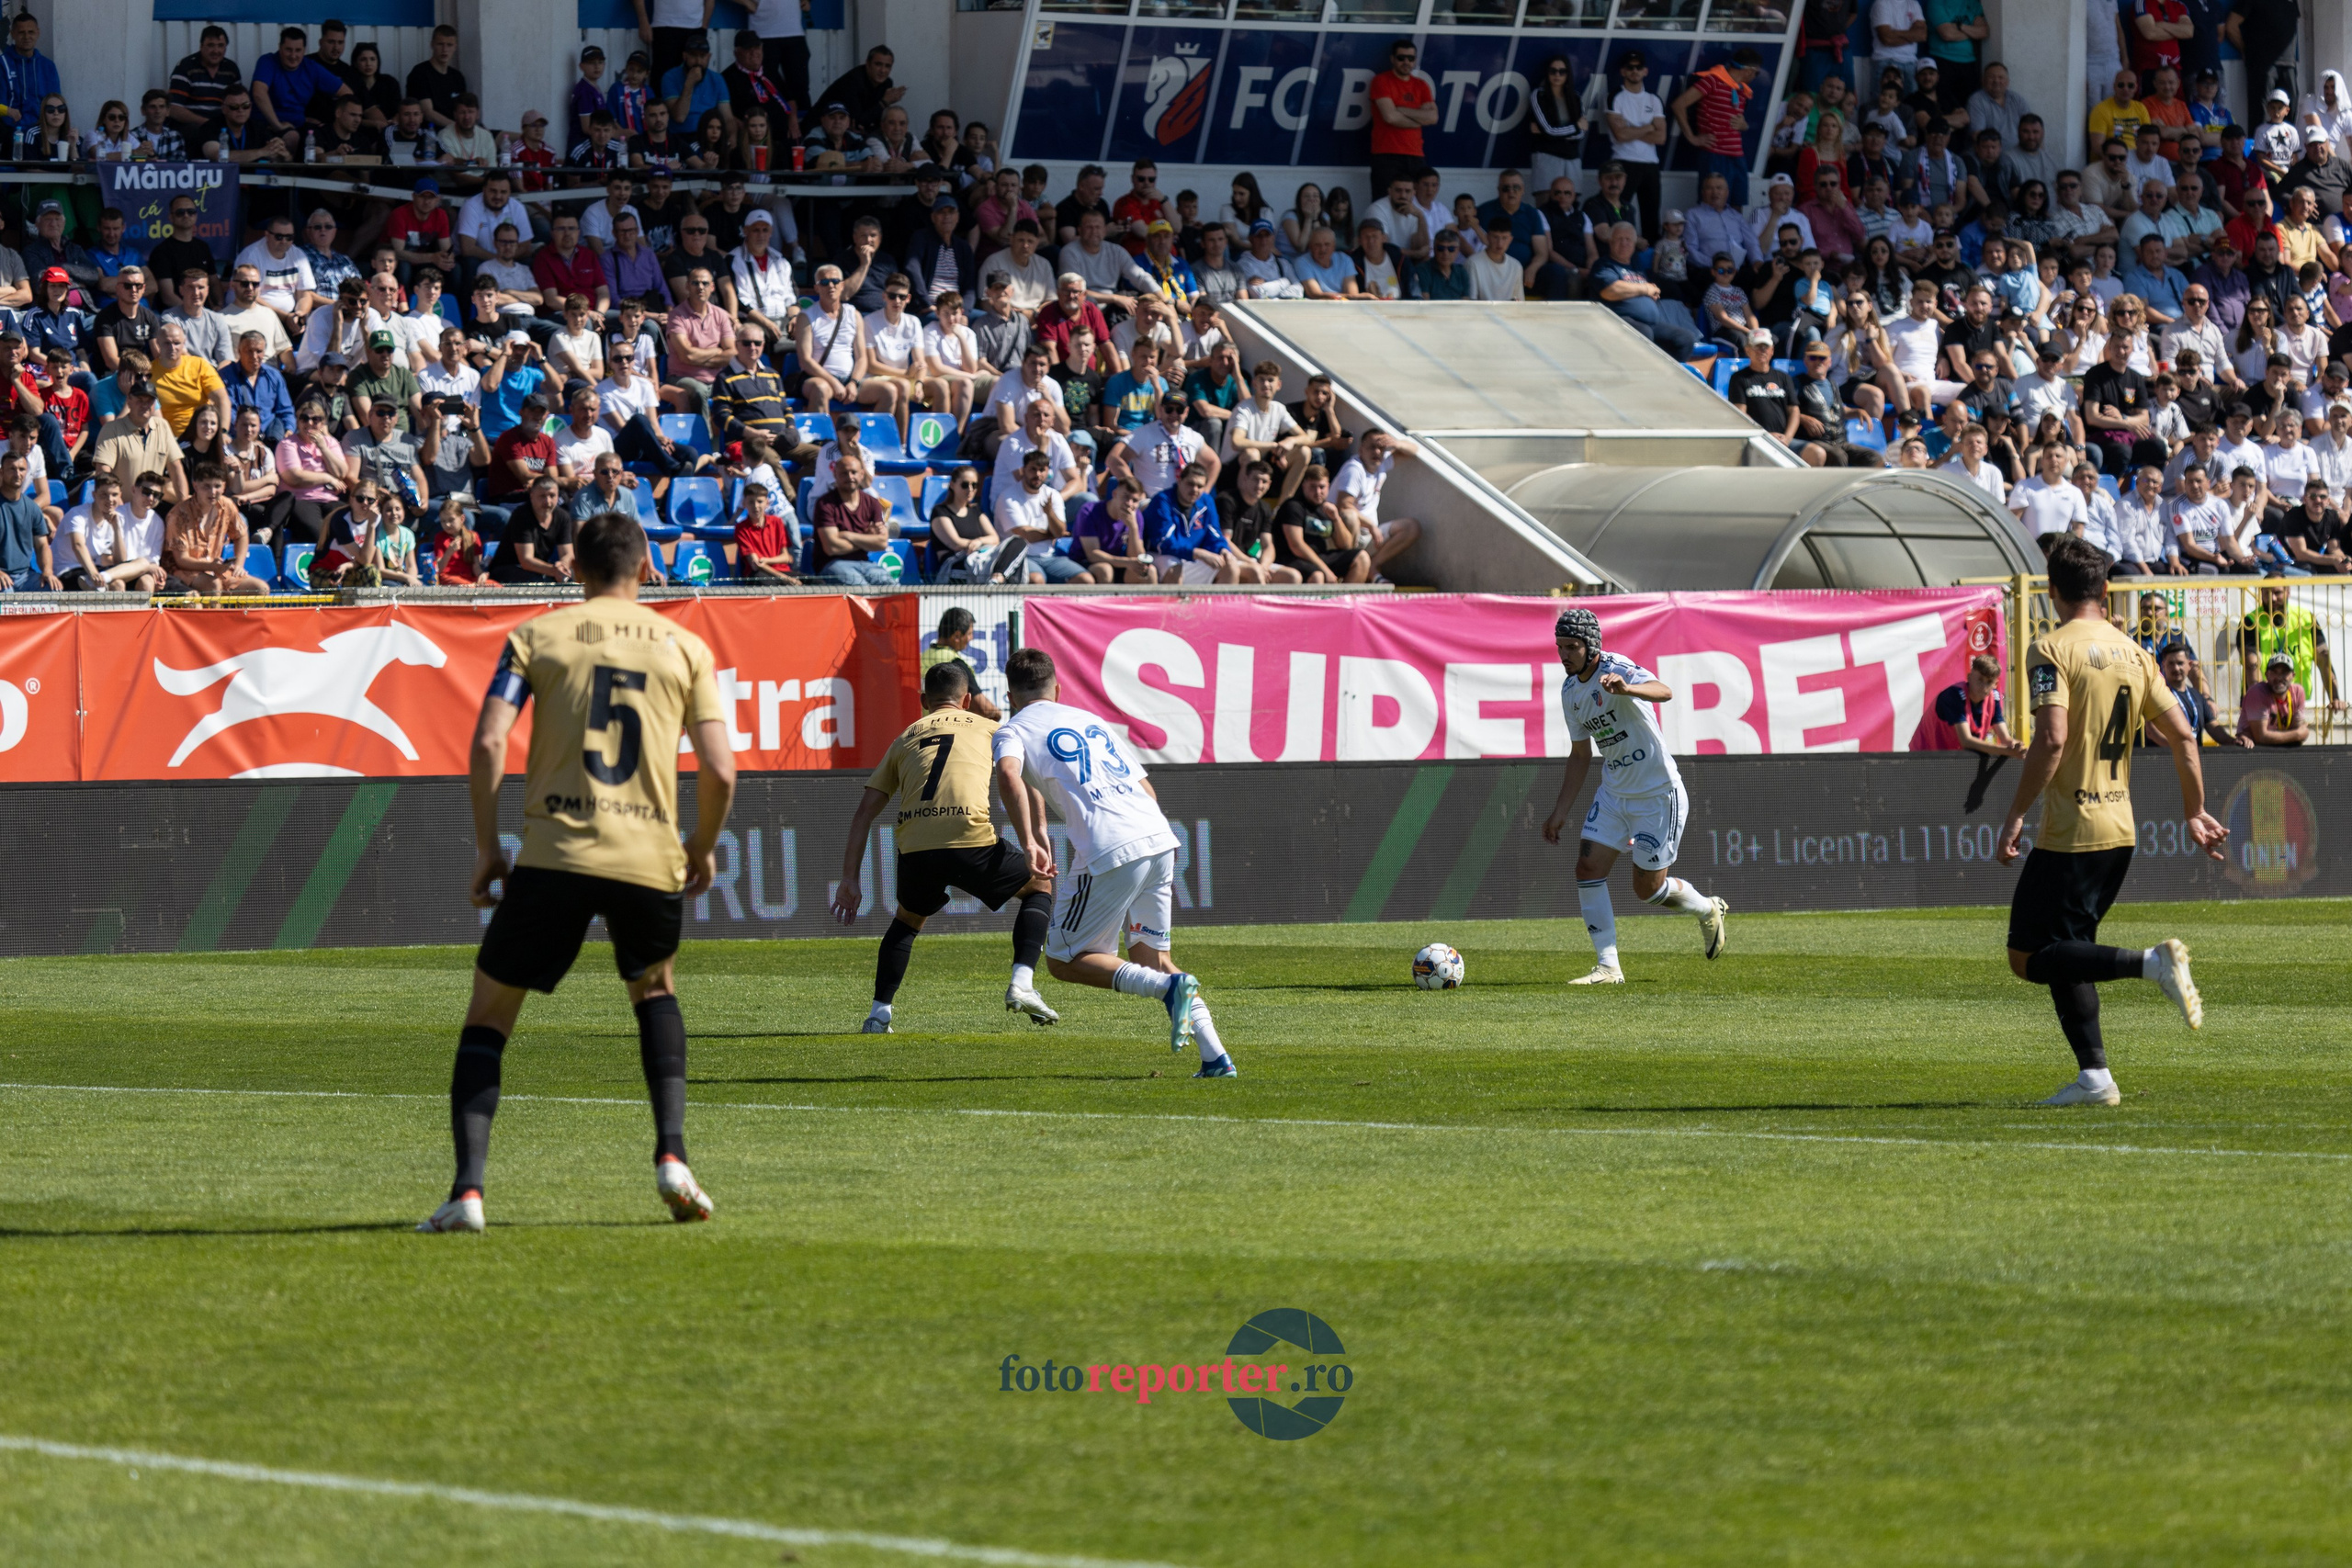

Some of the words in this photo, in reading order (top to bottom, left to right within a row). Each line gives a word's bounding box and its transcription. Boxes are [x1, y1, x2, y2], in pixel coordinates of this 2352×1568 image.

[1229, 66, 1318, 130] FC
[114, 164, 223, 190] Mândru
[2189, 595, 2219, 604] SECTOR
[681, 667, 855, 752] tra
[1101, 612, 1947, 763] SUPEBET
[582, 664, 647, 786] 5
[931, 716, 974, 725] HILS
[1582, 709, 1617, 732] NIBET
[2099, 685, 2132, 781] 4
[919, 733, 956, 802] 7
[1046, 724, 1131, 786] 93
[586, 795, 670, 824] HOSPITAL
[914, 807, 972, 818] HOSPITAL
[1708, 829, 1763, 865] 18+
